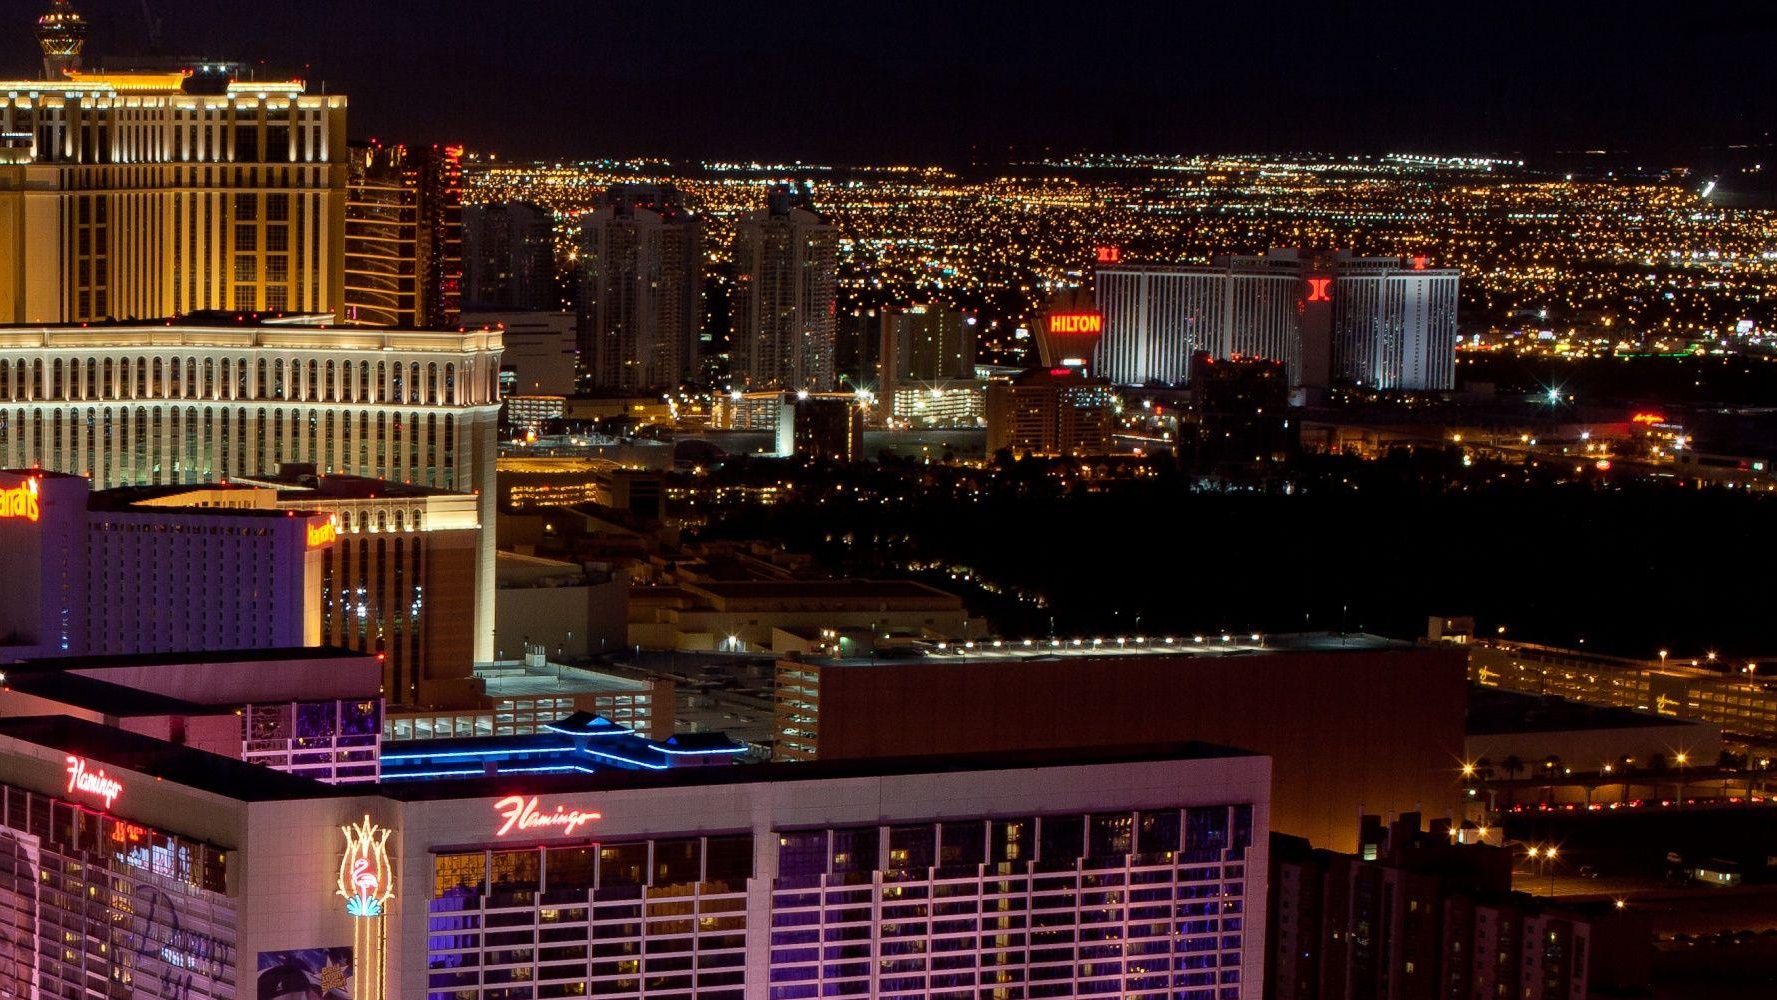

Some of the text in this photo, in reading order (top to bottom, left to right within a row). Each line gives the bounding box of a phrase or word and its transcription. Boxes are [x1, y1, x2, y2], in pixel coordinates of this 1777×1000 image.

[1051, 315, 1101, 332] HILTON
[67, 756, 123, 809] Flamingo
[494, 796, 601, 836] Flamingo
